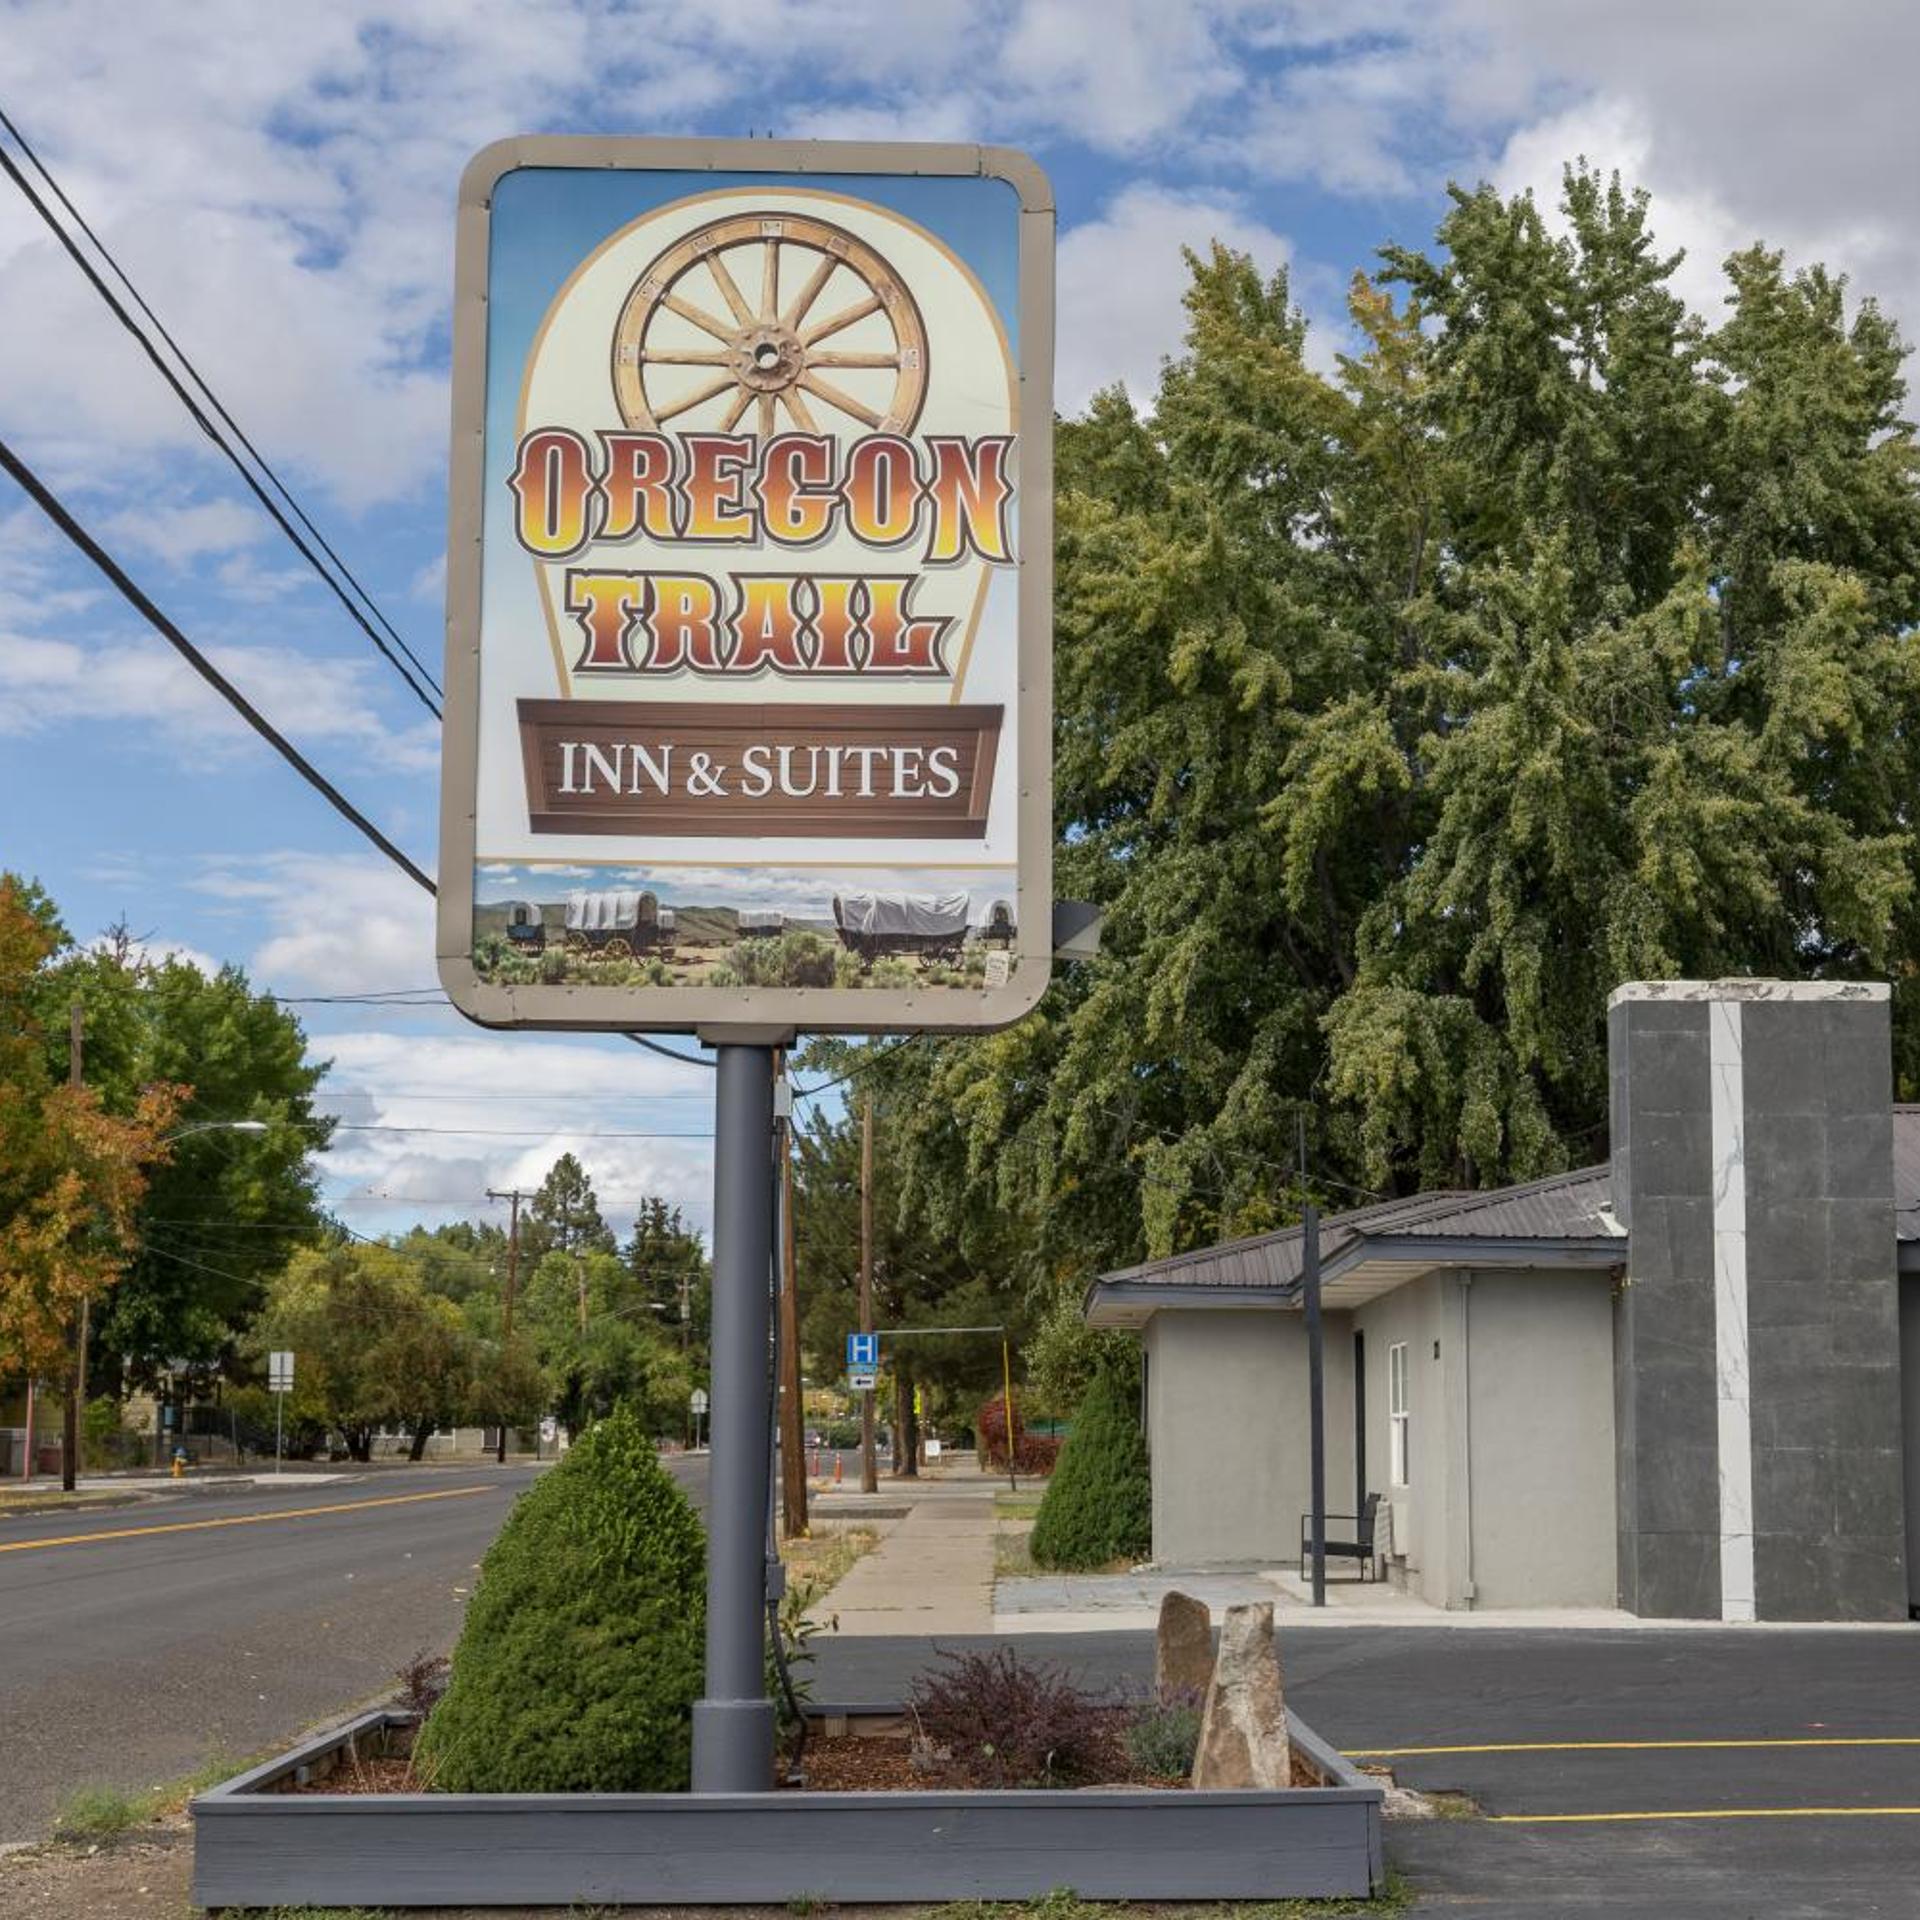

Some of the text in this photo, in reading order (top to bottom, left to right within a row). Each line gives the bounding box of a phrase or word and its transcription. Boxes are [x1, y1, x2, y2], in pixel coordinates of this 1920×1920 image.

[508, 427, 1017, 564] OREGON
[565, 568, 957, 676] TRAIL
[557, 742, 961, 799] INN & SUITES
[853, 1335, 873, 1362] H
